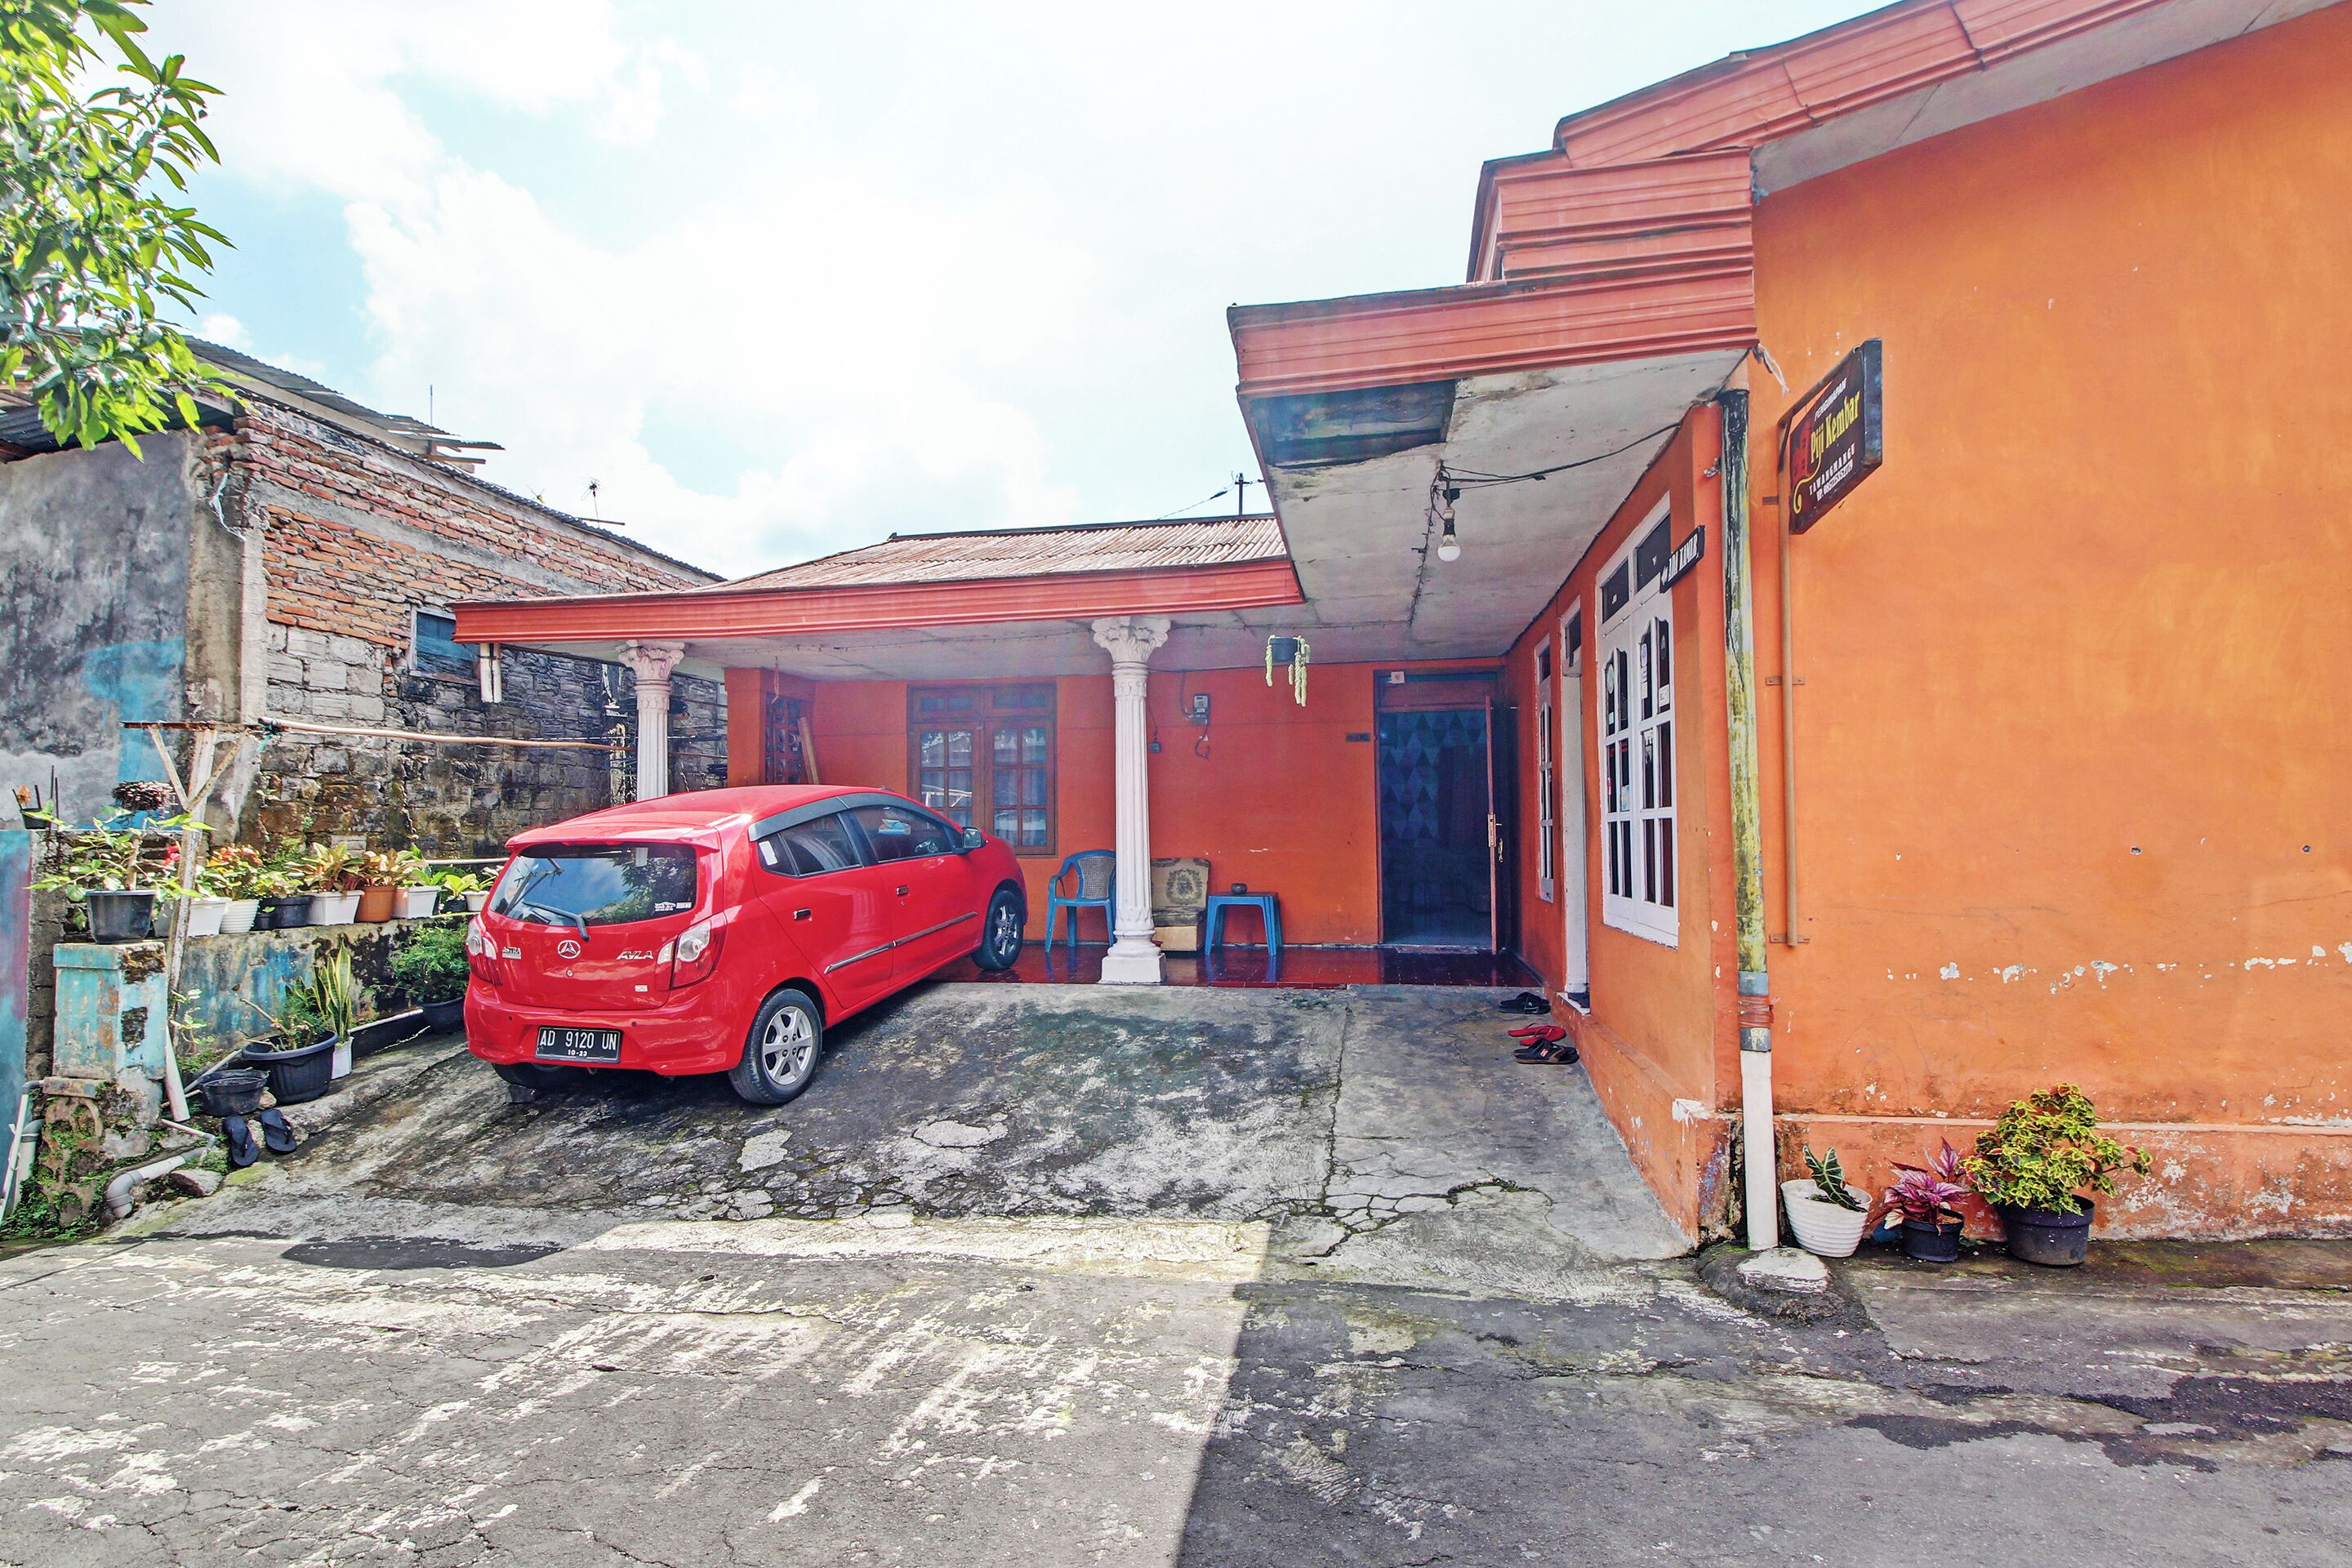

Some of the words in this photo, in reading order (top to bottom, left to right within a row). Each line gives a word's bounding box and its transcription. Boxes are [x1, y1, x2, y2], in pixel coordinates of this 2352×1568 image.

[1825, 390, 1860, 450] Kembar
[1809, 443, 1855, 496] TAWANGMANGU
[616, 951, 654, 960] AYLA
[539, 1030, 556, 1047] AD
[565, 1031, 595, 1049] 9120
[602, 1033, 617, 1050] UN
